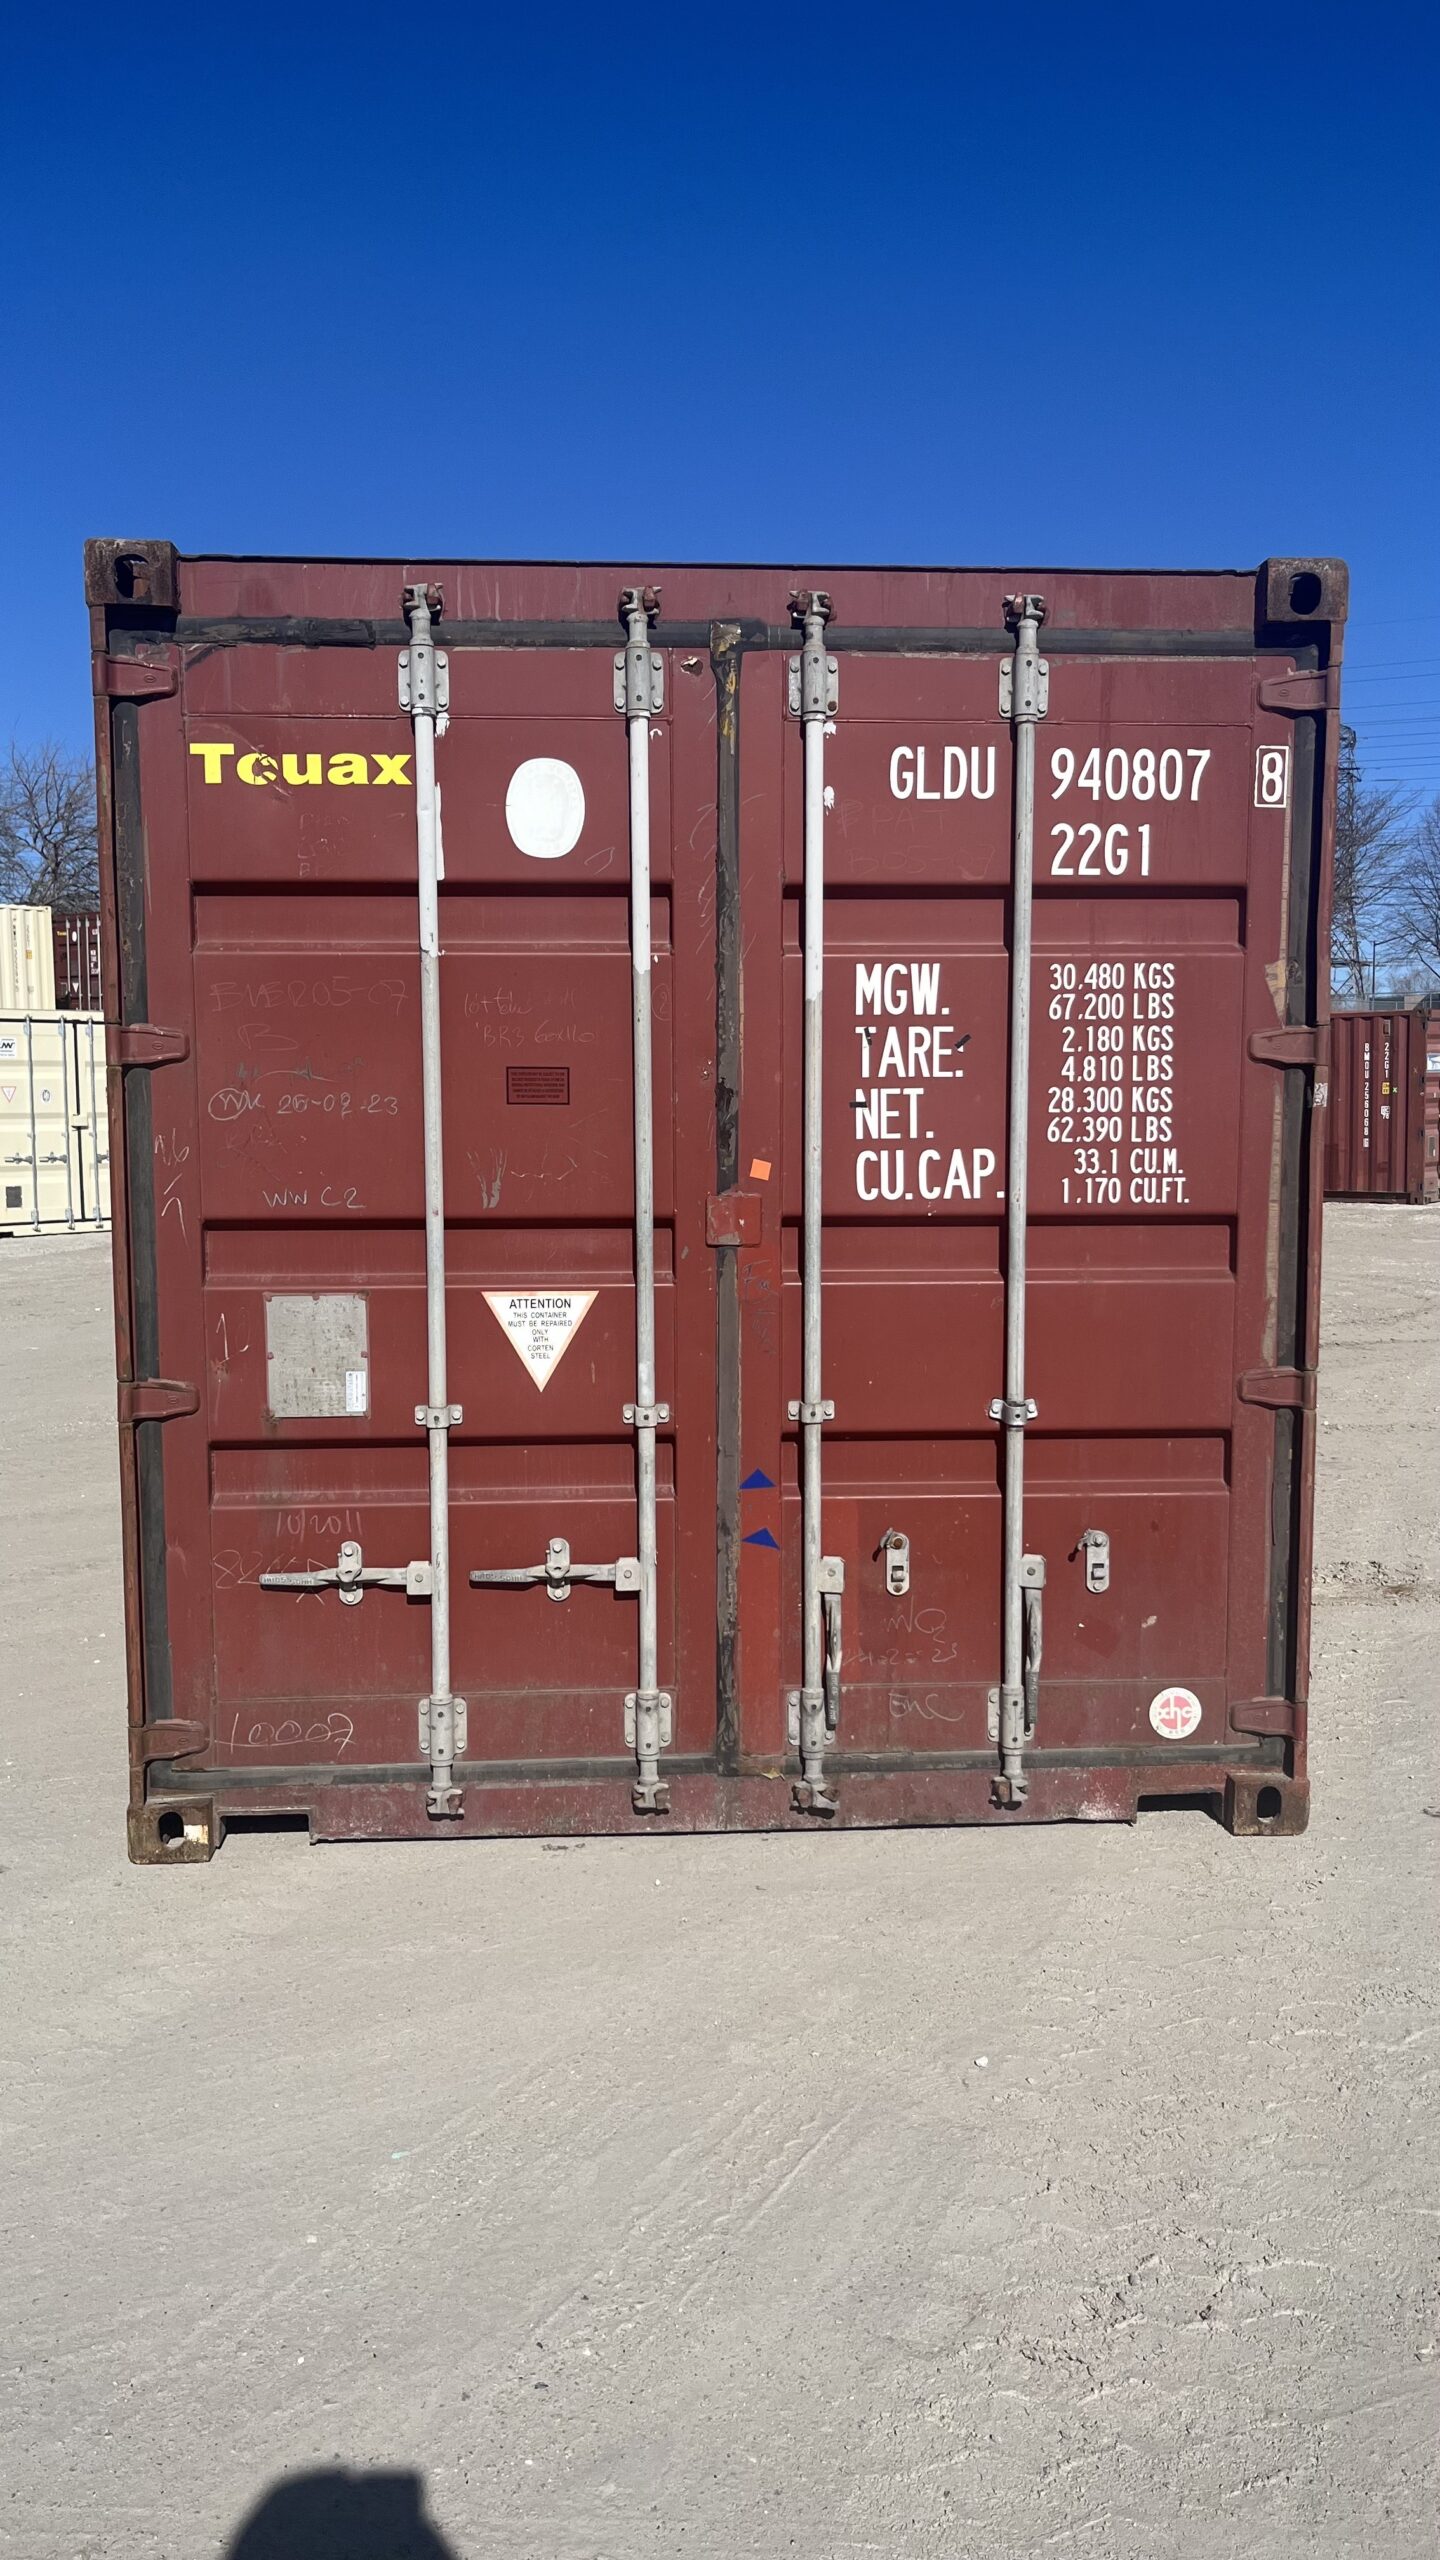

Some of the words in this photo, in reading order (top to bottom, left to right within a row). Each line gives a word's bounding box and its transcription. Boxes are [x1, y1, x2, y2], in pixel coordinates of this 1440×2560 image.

[889, 745, 996, 800] GLDU
[1050, 747, 1212, 802] 940807
[1261, 751, 1285, 803] 8
[1050, 822, 1151, 877] 22G1
[855, 963, 950, 1016] MGW.
[1049, 962, 1125, 991] 30,480
[1133, 962, 1176, 990] KGS
[1048, 992, 1125, 1021] 67,200
[1133, 992, 1175, 1020] LBS
[1132, 1024, 1174, 1052] KGS
[1061, 1055, 1124, 1083] 4,810
[1132, 1054, 1174, 1082] LBS
[855, 1087, 935, 1140] NET.
[1048, 1086, 1123, 1113] 28,300
[1131, 1086, 1174, 1113] KGS
[1047, 1116, 1123, 1143] 62,390
[1130, 1115, 1173, 1143] LBS
[856, 1148, 1005, 1201] CU.CAP.
[1073, 1148, 1118, 1175] 33.1
[1129, 1147, 1184, 1174] CU.M.
[509, 1298, 571, 1309] ATTENTION
[530, 1311, 567, 1319] CONTAINER
[508, 1320, 526, 1328] MUST
[541, 1319, 573, 1327] REPAIRED
[532, 1328, 549, 1336] ONLY
